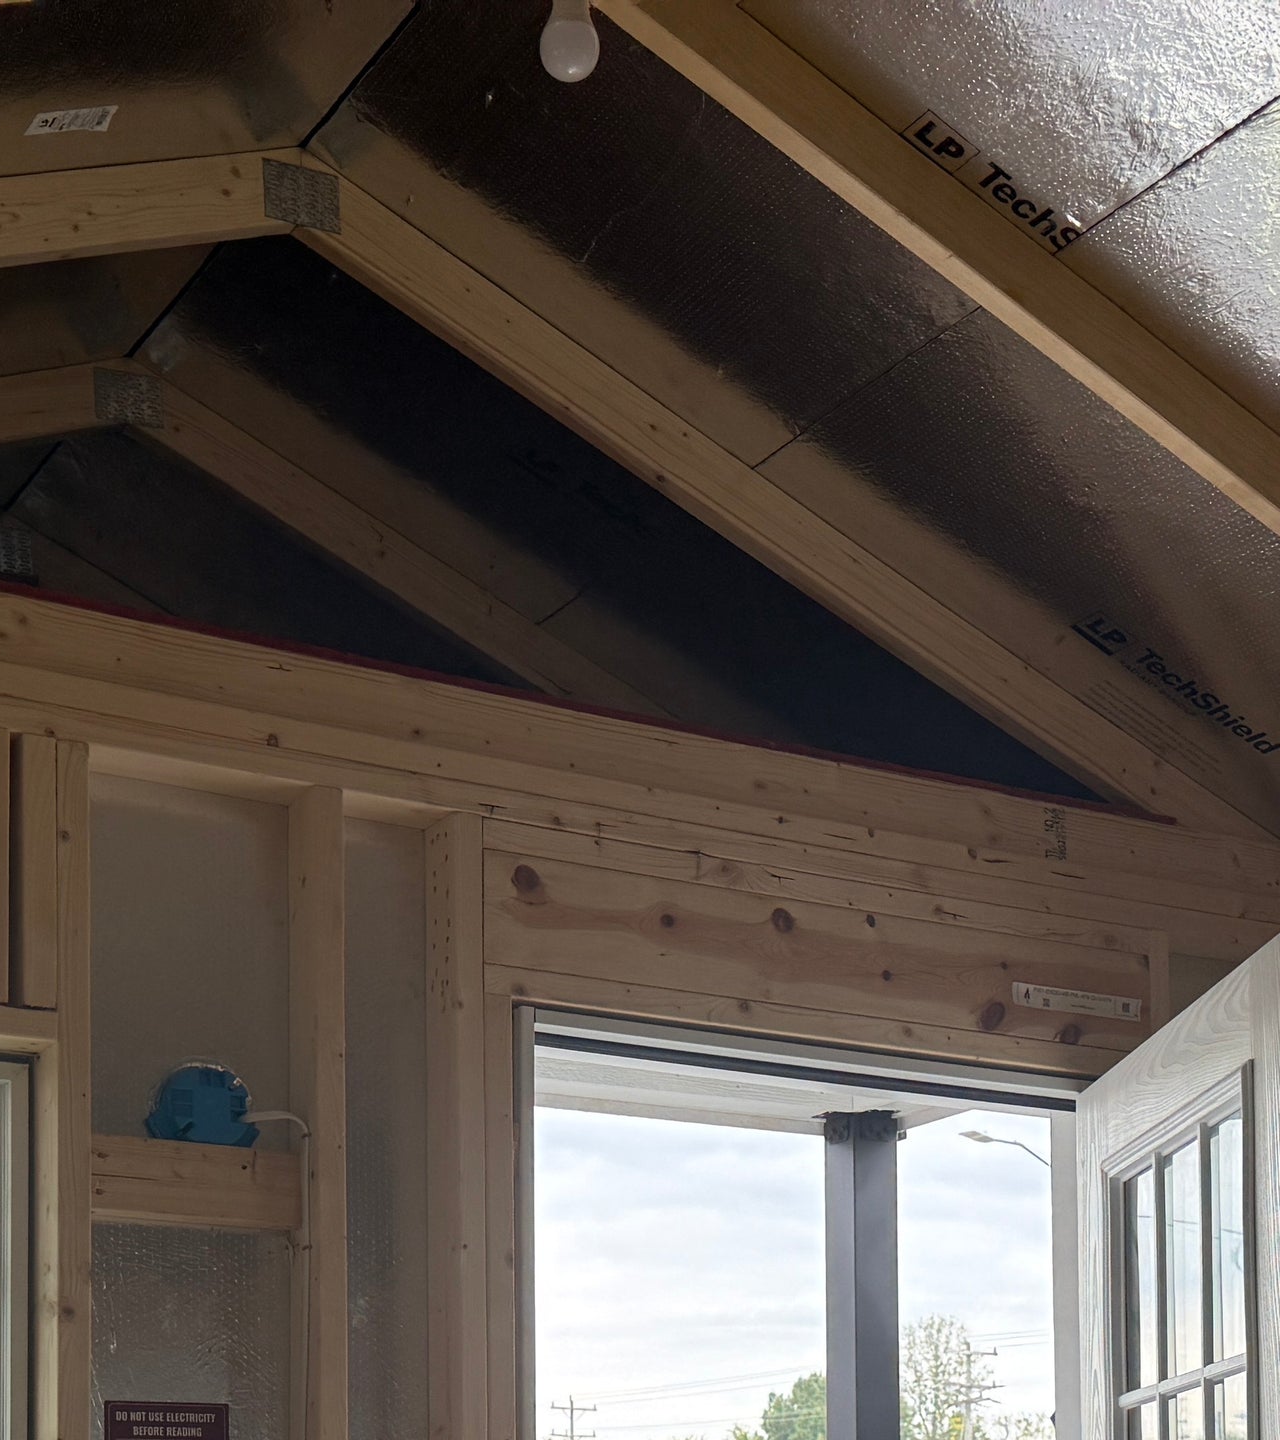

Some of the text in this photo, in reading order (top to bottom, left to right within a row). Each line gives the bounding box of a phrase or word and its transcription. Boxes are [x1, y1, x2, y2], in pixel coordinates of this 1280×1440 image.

[913, 120, 1083, 251] LP TechS
[1086, 616, 1128, 646] LP
[115, 1410, 216, 1424] DO NOT USE ELECTRICITY
[133, 1426, 202, 1438] BEFORE READING
